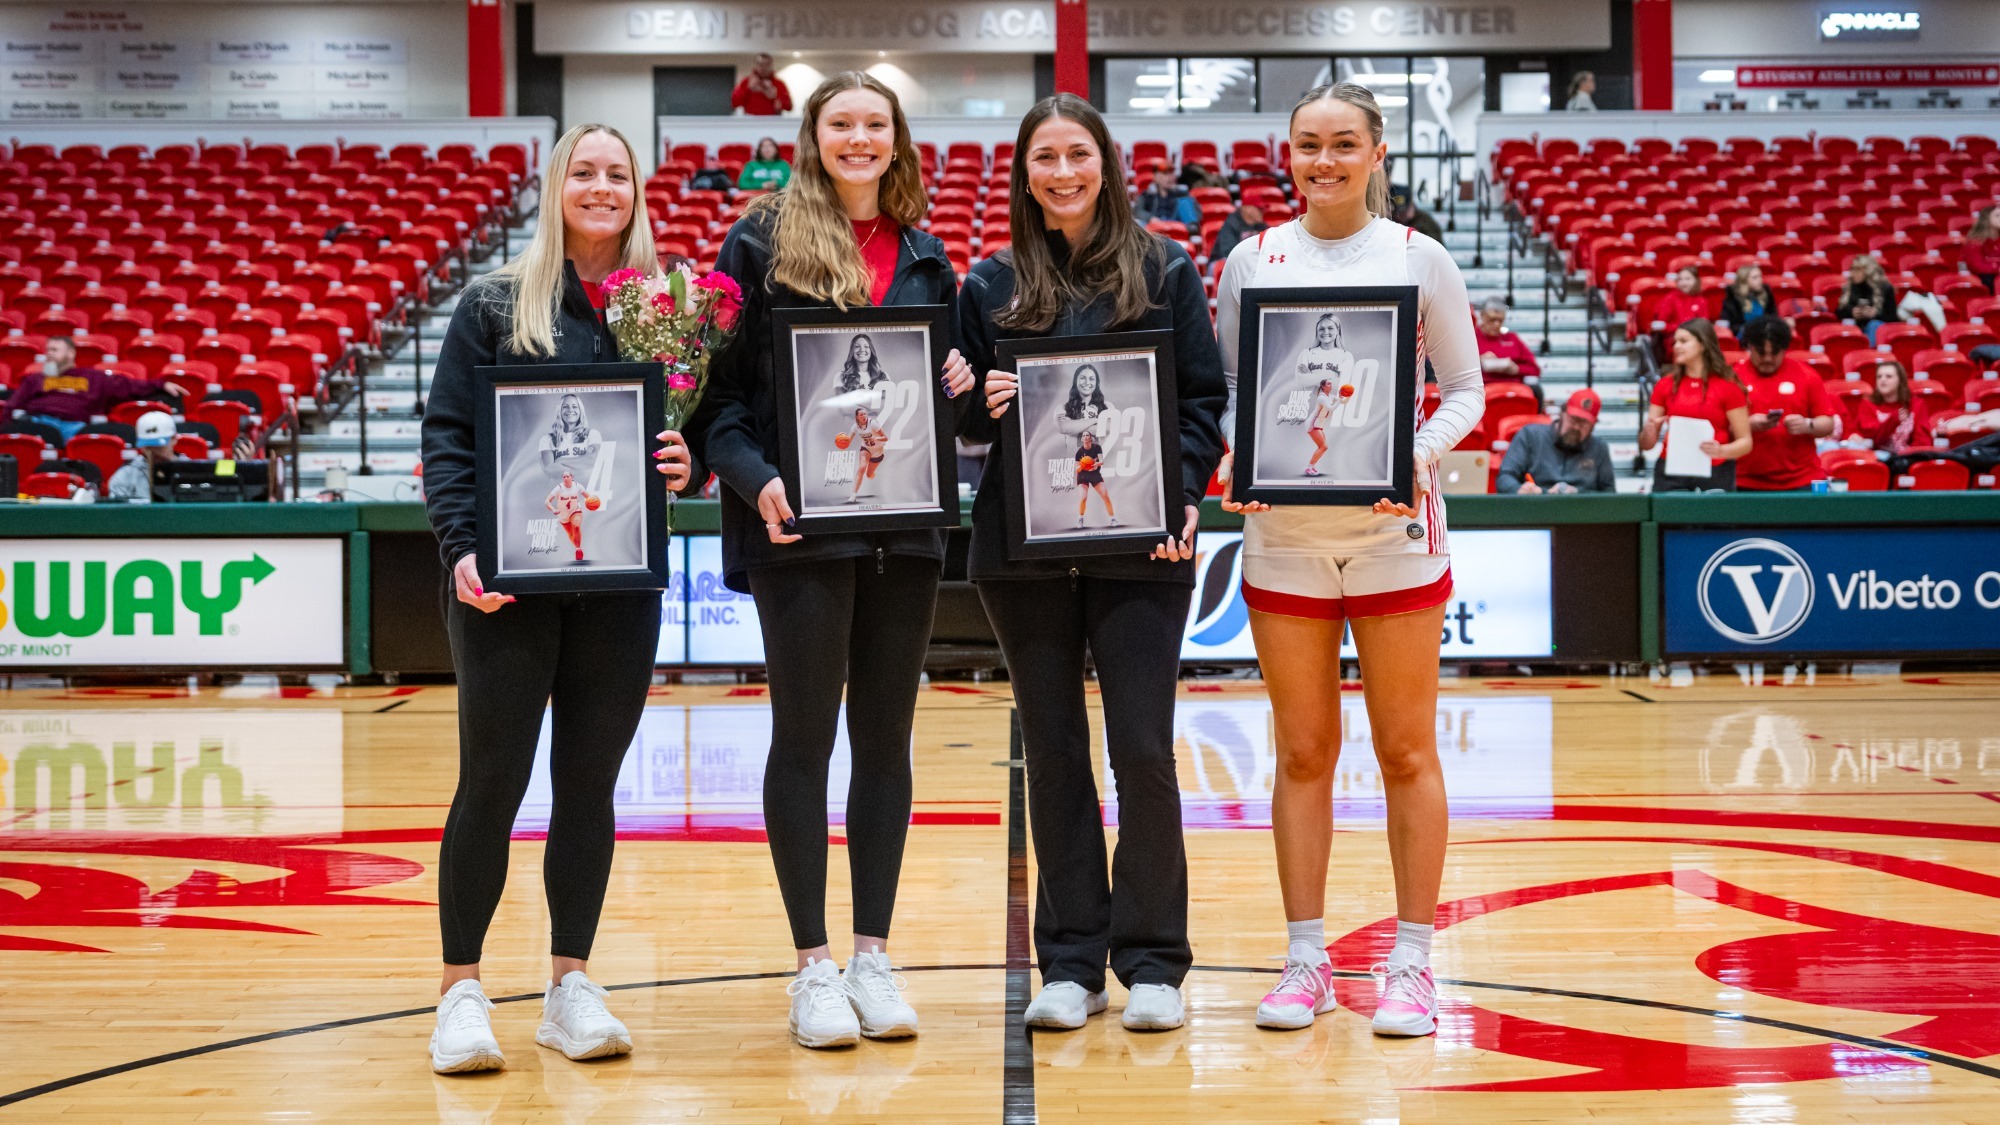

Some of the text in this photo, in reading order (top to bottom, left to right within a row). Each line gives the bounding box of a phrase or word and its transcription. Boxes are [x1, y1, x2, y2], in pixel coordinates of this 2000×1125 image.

[628, 9, 727, 39] DEAN
[976, 9, 1168, 39] ACAEMIC
[1192, 8, 1357, 38] SUCCESS
[1370, 7, 1517, 36] CENTER
[1755, 69, 1982, 82] STUDENT ATHLETES OF THE MONTH
[1089, 353, 1137, 362] UNIVERSITY
[574, 385, 624, 393] UNIVERSITY
[871, 380, 919, 450] 22
[1096, 406, 1146, 478] 23
[827, 450, 857, 466] LORELEI
[1047, 458, 1076, 474] TAYLOR
[586, 441, 617, 511] 4
[825, 465, 855, 481] NELSON
[1052, 472, 1075, 487] GOSS
[566, 500, 571, 510] 4
[526, 518, 560, 536] NATALIE
[0, 552, 277, 638] WAY
[1827, 569, 1962, 610] Vibeto
[700, 606, 740, 625] INC.
[22, 644, 73, 657] MINOT
